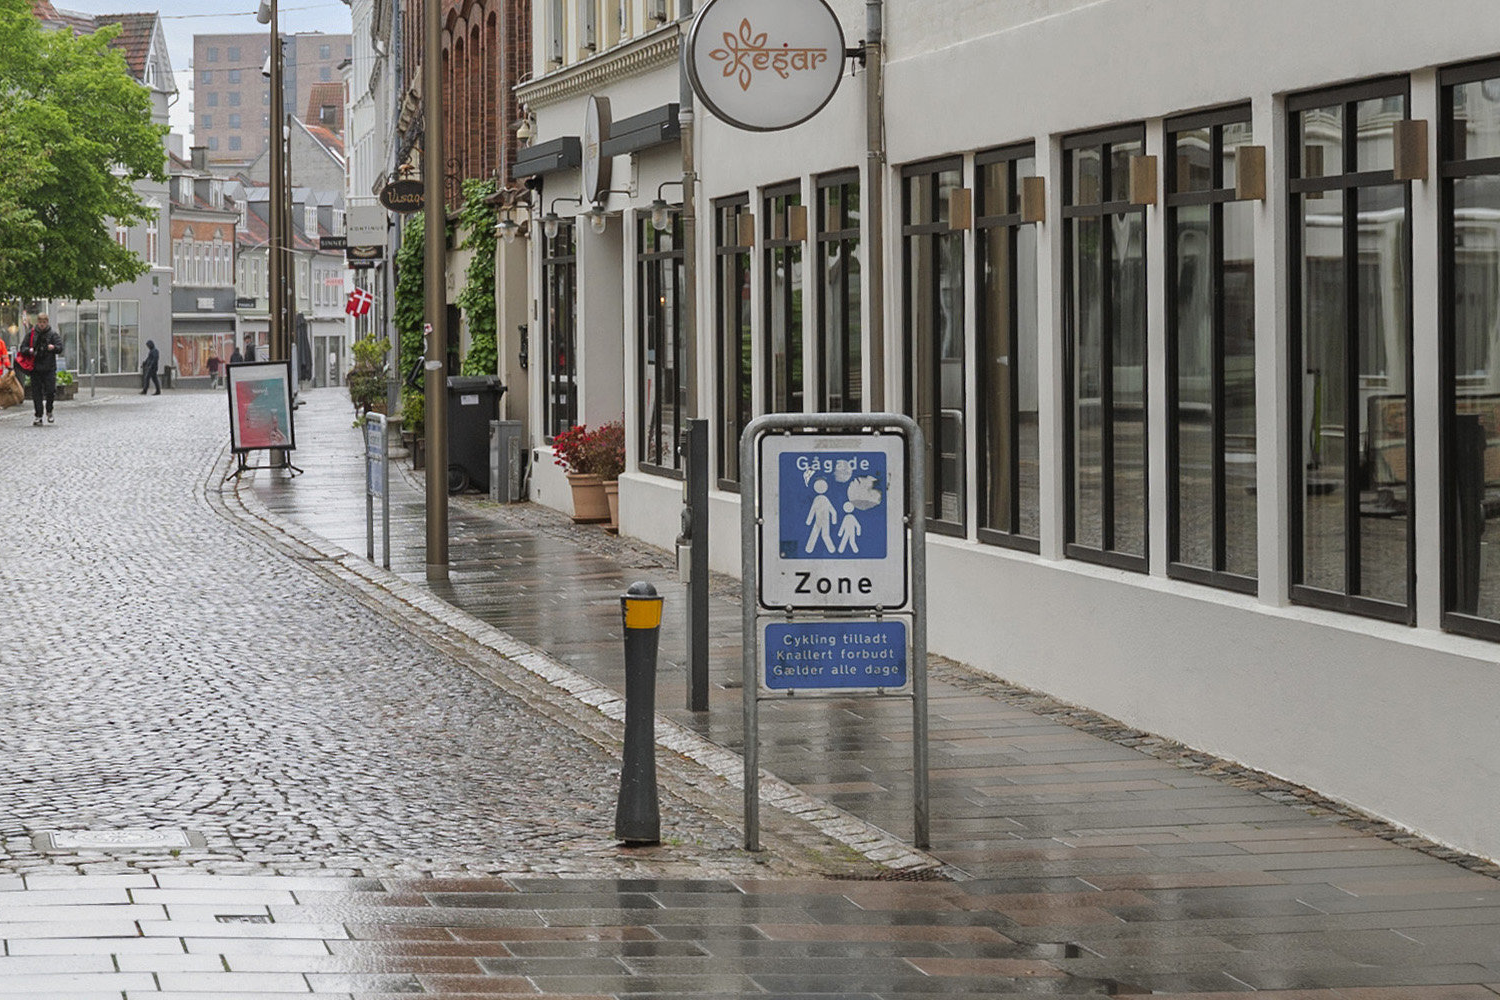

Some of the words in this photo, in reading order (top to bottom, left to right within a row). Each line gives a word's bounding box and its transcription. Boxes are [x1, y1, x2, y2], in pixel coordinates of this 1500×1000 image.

[796, 456, 870, 473] Gågade
[795, 572, 873, 594] Zone
[783, 634, 836, 647] Cykling
[843, 633, 887, 645] tilladt
[776, 649, 833, 660] Knallert
[841, 649, 894, 659] forbudt
[773, 665, 824, 676] Gælder
[831, 664, 857, 675] alle
[865, 664, 899, 676] dage
